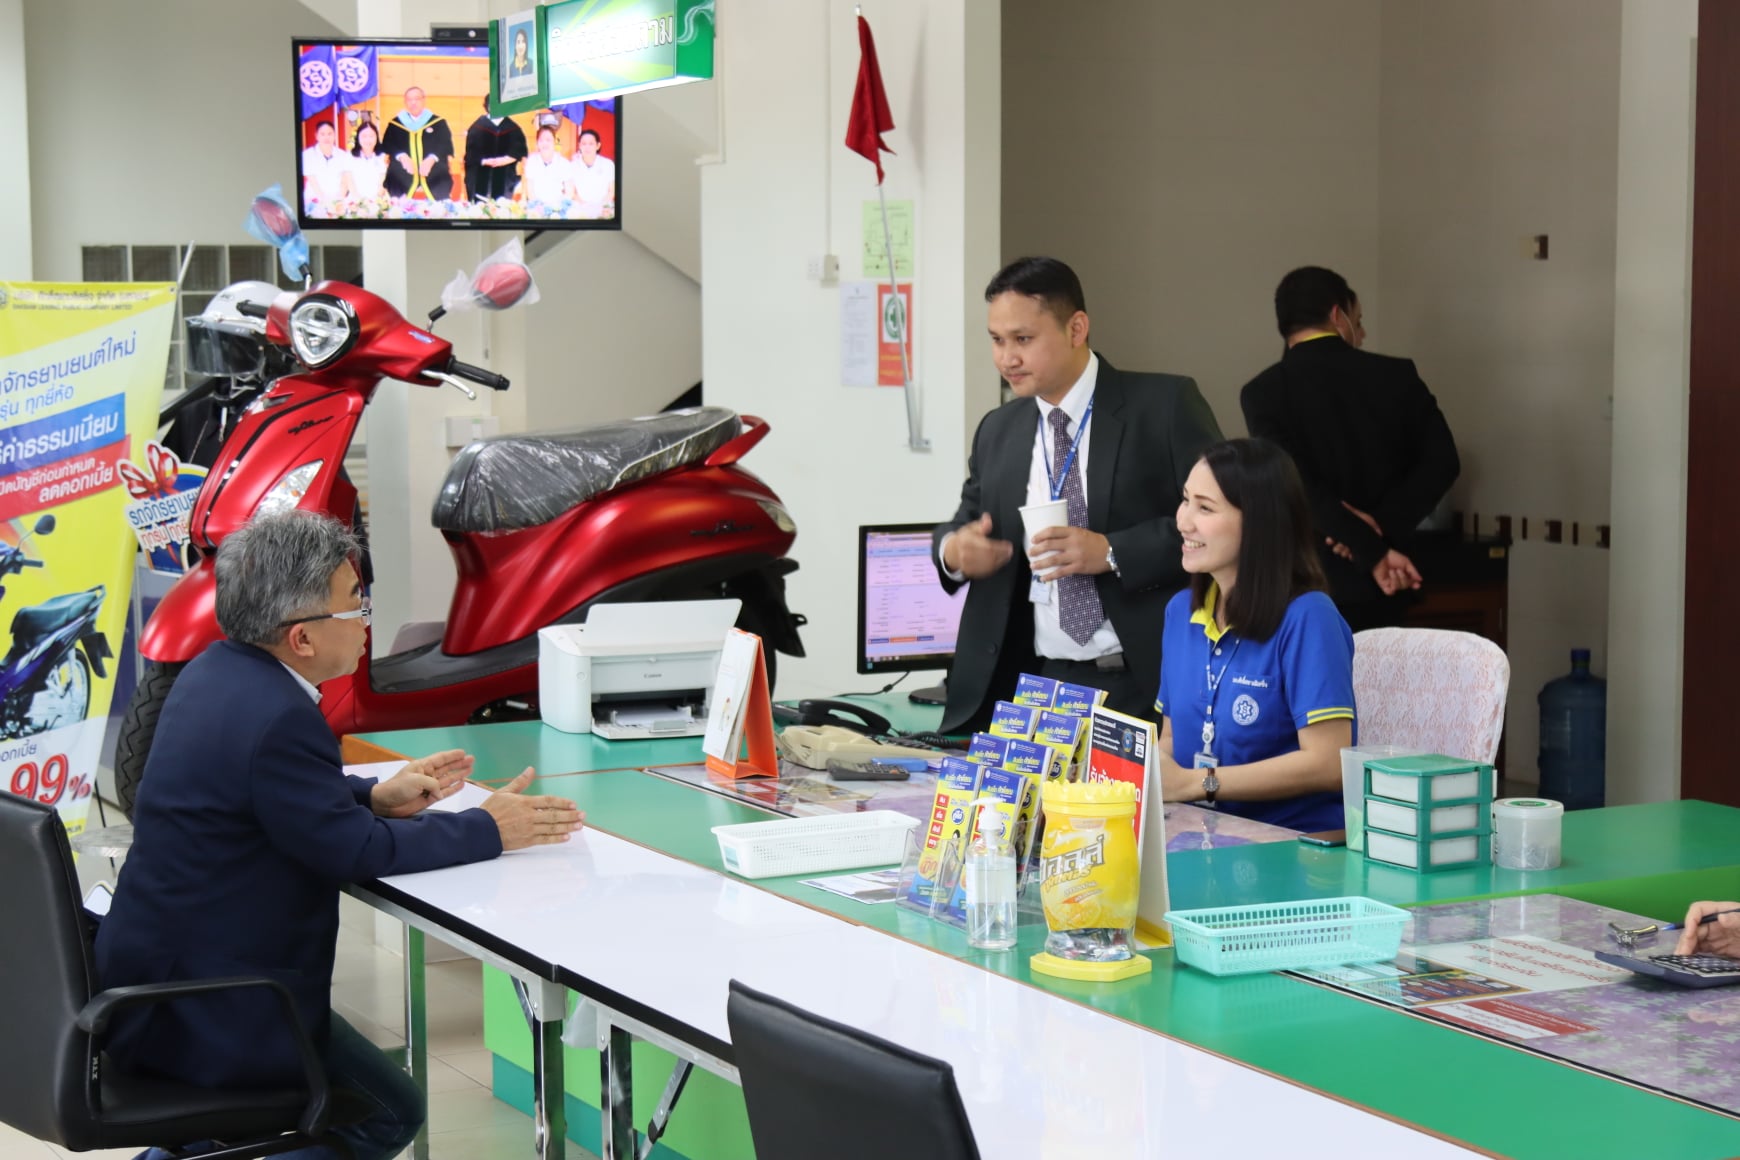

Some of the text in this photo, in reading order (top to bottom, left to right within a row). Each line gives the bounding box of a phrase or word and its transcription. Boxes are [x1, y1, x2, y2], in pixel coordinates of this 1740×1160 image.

[0, 330, 136, 396] จักรยานยนต์ใหม่
[0, 412, 119, 465] ค่าธรรมเนียม
[39, 461, 114, 503] ลดดอกเบี้ย
[0, 739, 37, 762] อกเบี้ย
